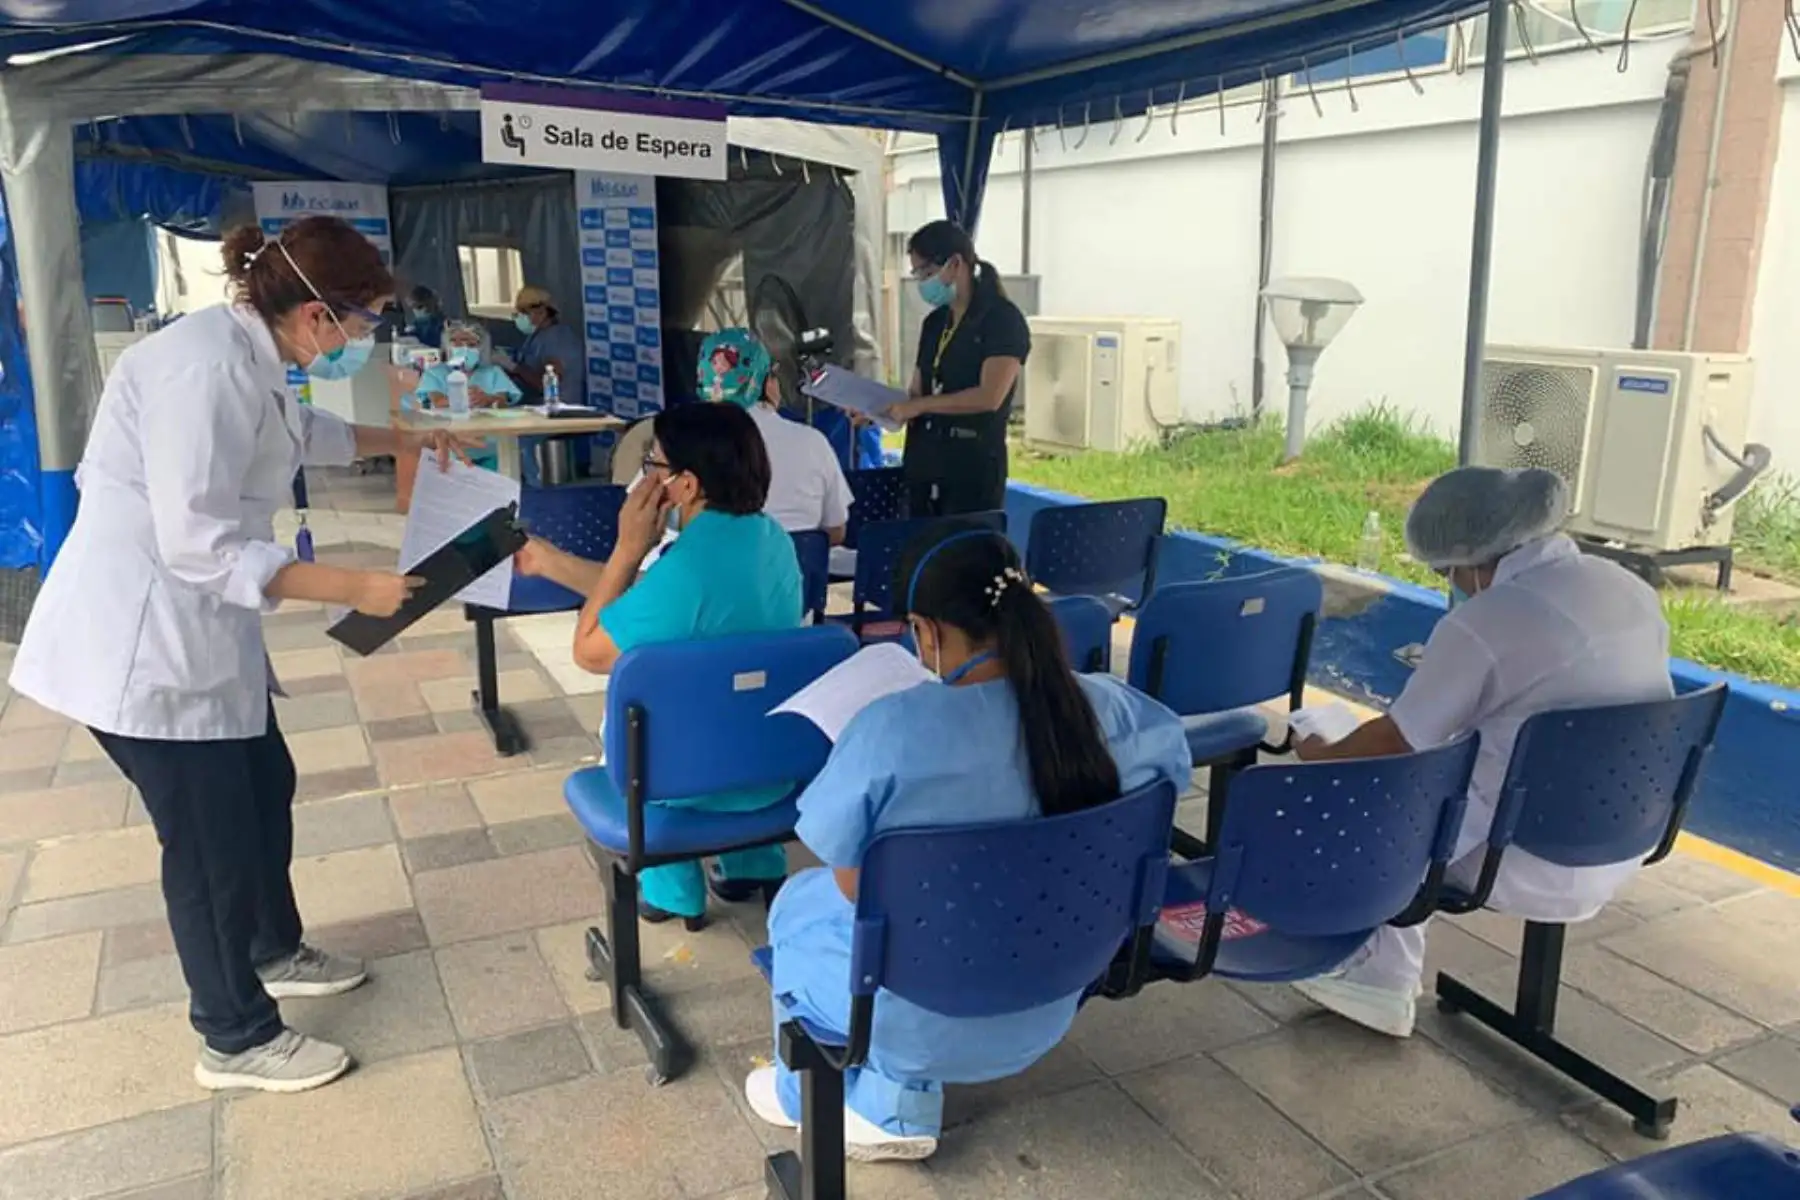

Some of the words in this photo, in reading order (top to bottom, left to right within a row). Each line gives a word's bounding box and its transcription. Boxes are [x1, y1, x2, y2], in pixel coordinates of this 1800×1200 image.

[544, 124, 594, 148] Sala
[601, 130, 629, 151] de
[636, 133, 712, 160] Espera
